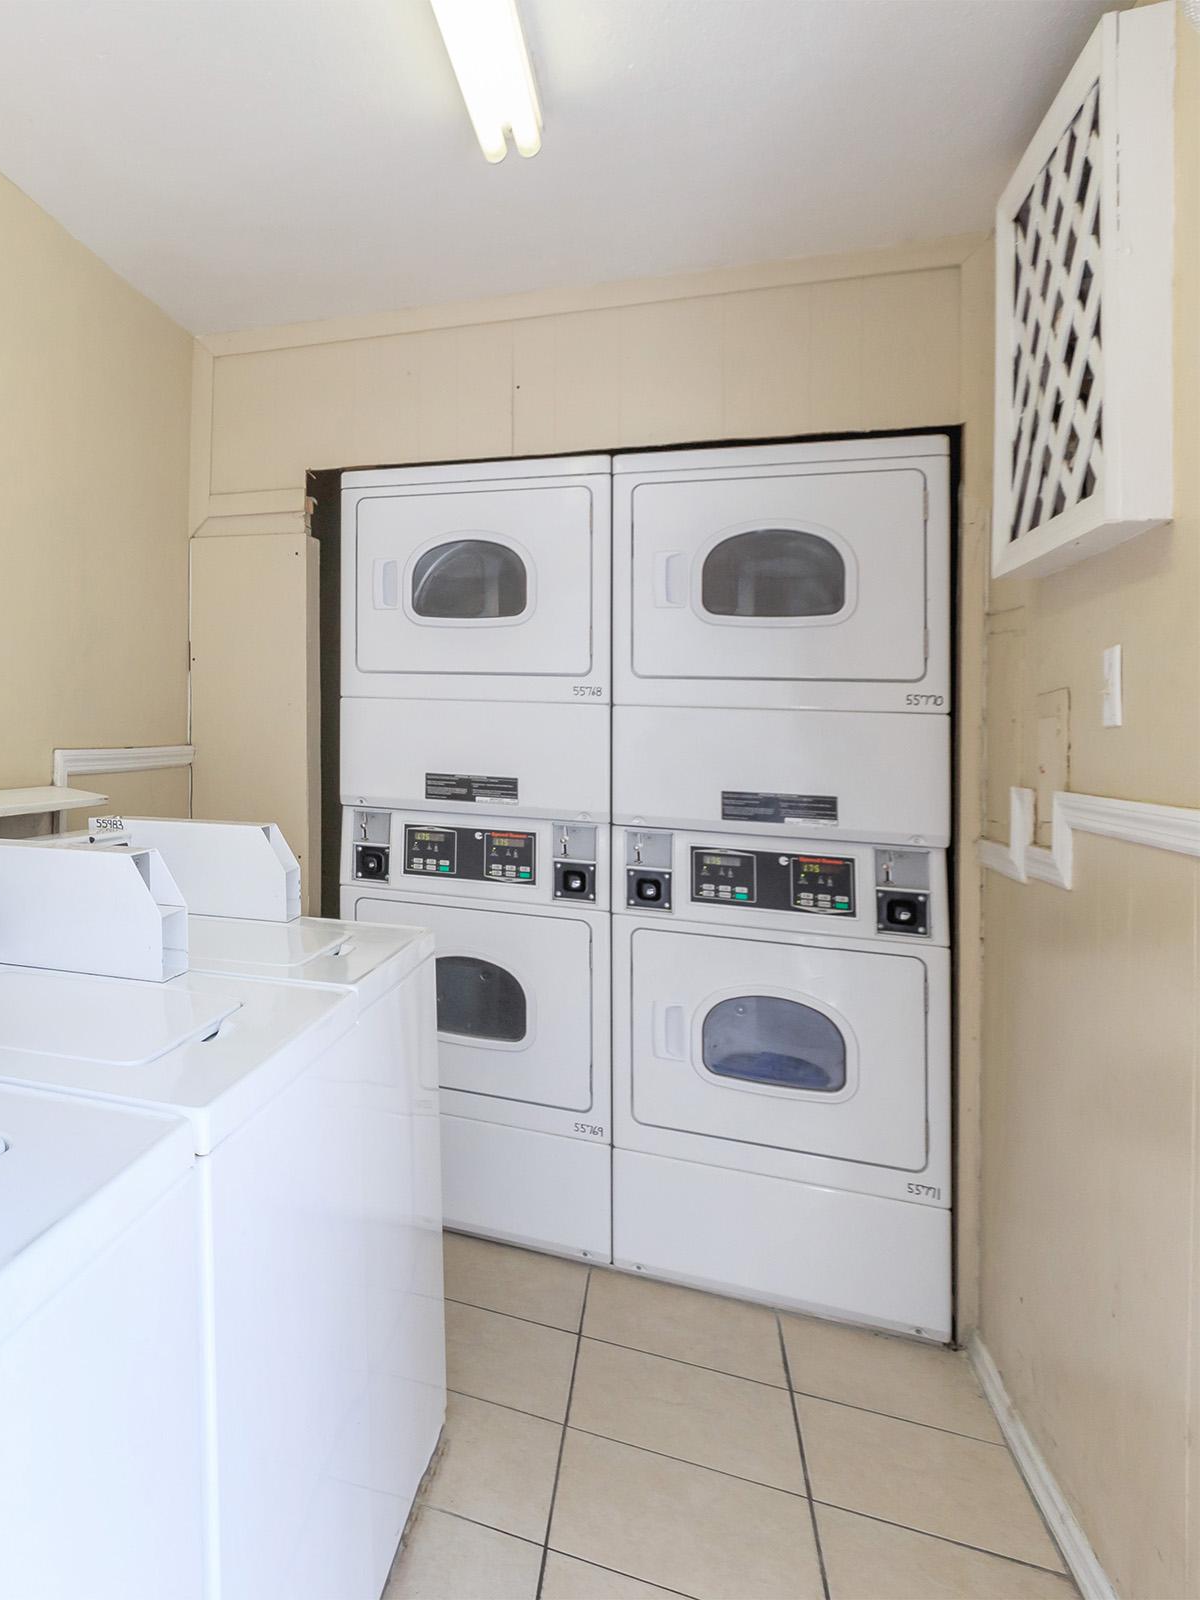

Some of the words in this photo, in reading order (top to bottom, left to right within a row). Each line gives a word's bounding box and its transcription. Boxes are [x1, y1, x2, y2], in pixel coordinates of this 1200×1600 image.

[906, 694, 945, 706] 55770
[574, 1122, 604, 1137] 55769
[907, 1183, 941, 1200] 55771
